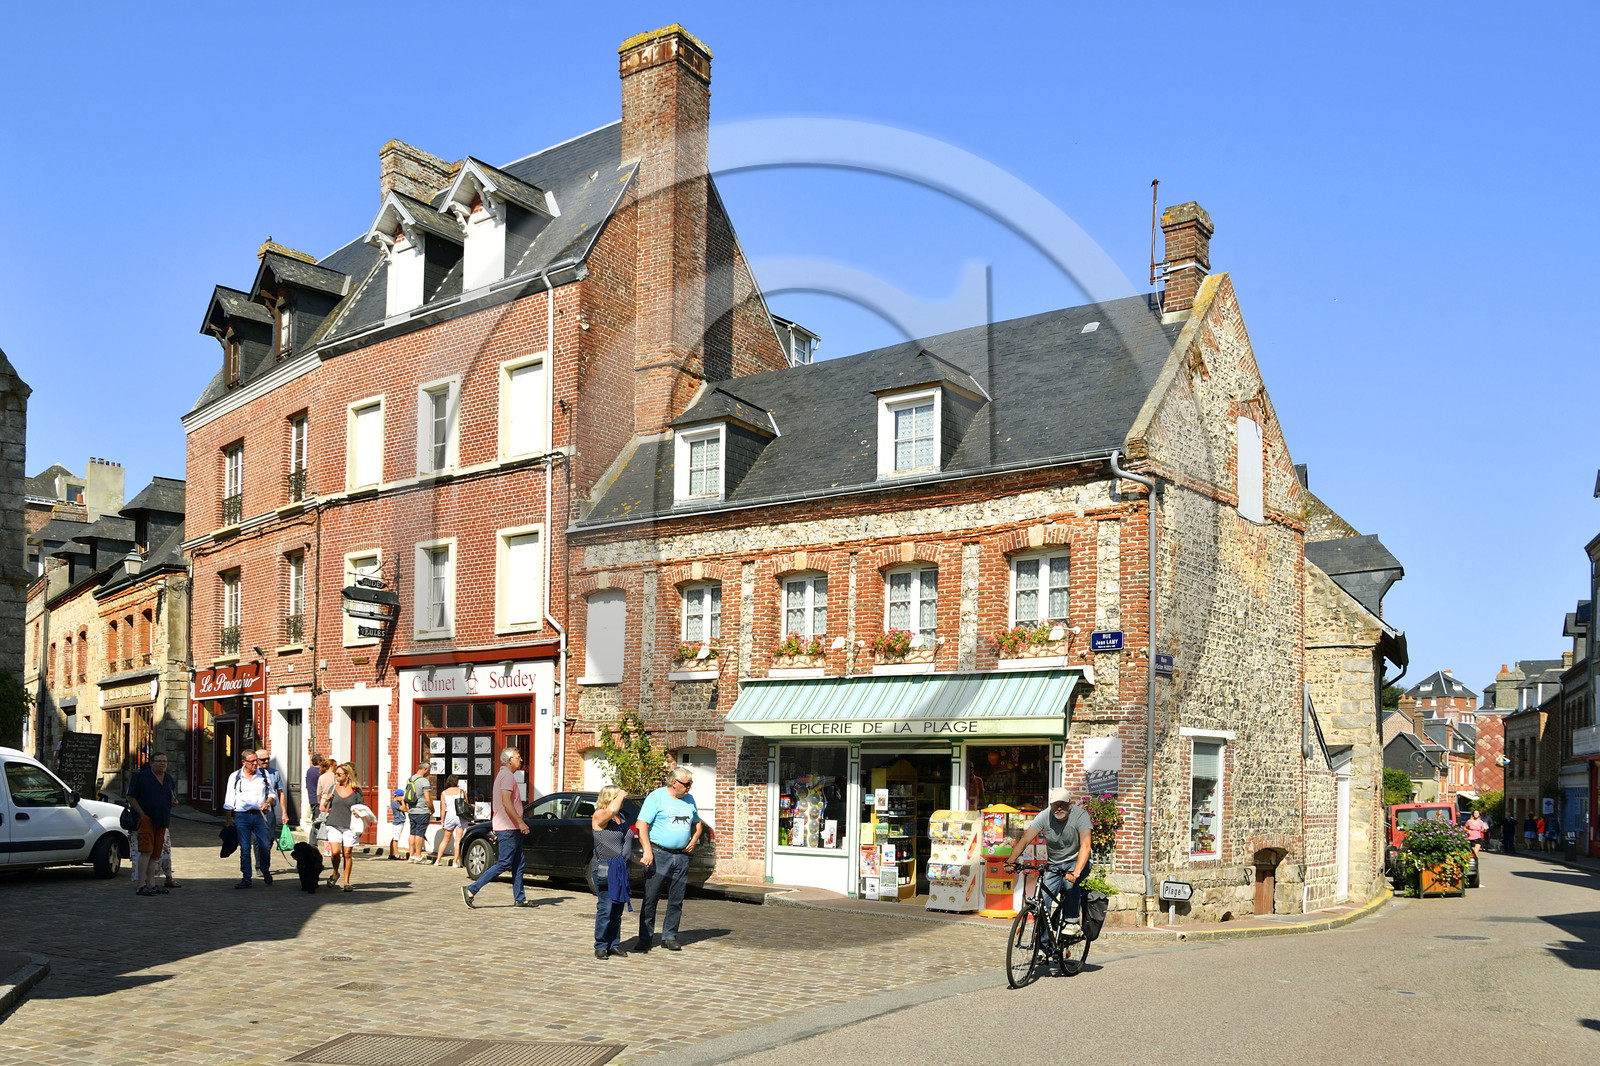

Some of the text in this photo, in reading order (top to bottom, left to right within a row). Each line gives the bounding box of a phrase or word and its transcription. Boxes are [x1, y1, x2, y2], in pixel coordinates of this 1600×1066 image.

[361, 578, 384, 588] SOUDEY
[361, 627, 385, 636] VEULES
[200, 672, 261, 693] Le Pinocchio
[412, 669, 537, 692] Cabinet Soudey
[790, 720, 978, 735] EPICERIE DE LA PLAGE
[1165, 885, 1181, 898] Plage
